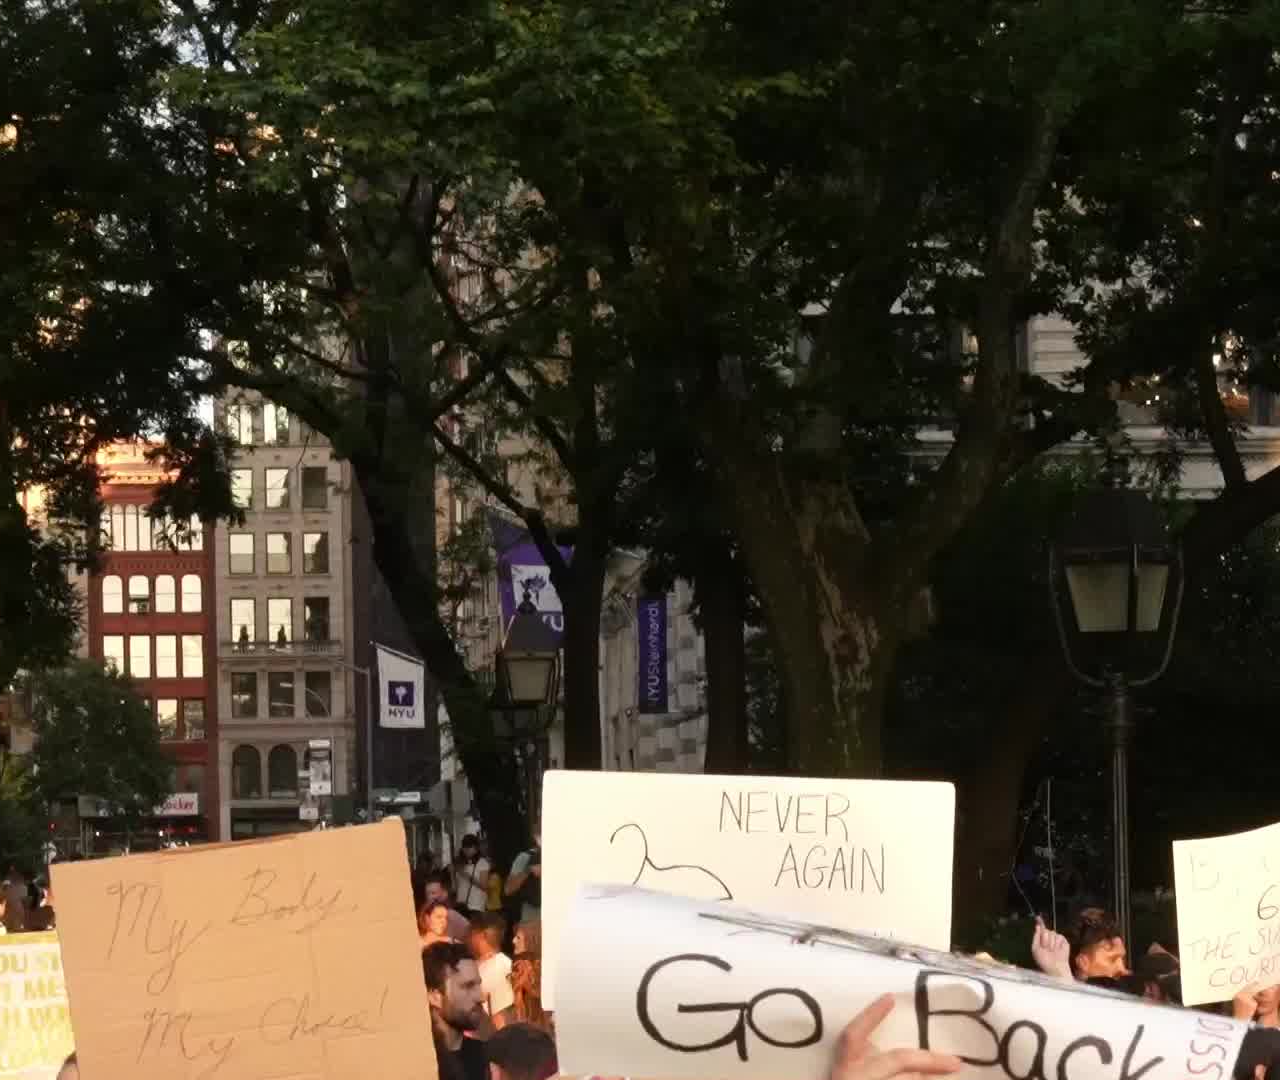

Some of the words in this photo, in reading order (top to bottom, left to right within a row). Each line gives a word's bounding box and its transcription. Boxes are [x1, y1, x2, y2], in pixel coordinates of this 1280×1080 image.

[388, 707, 416, 719] NYU
[719, 791, 850, 842] NEVER
[774, 844, 885, 895] AGAIN
[105, 880, 213, 997] My
[636, 952, 824, 1062] Go
